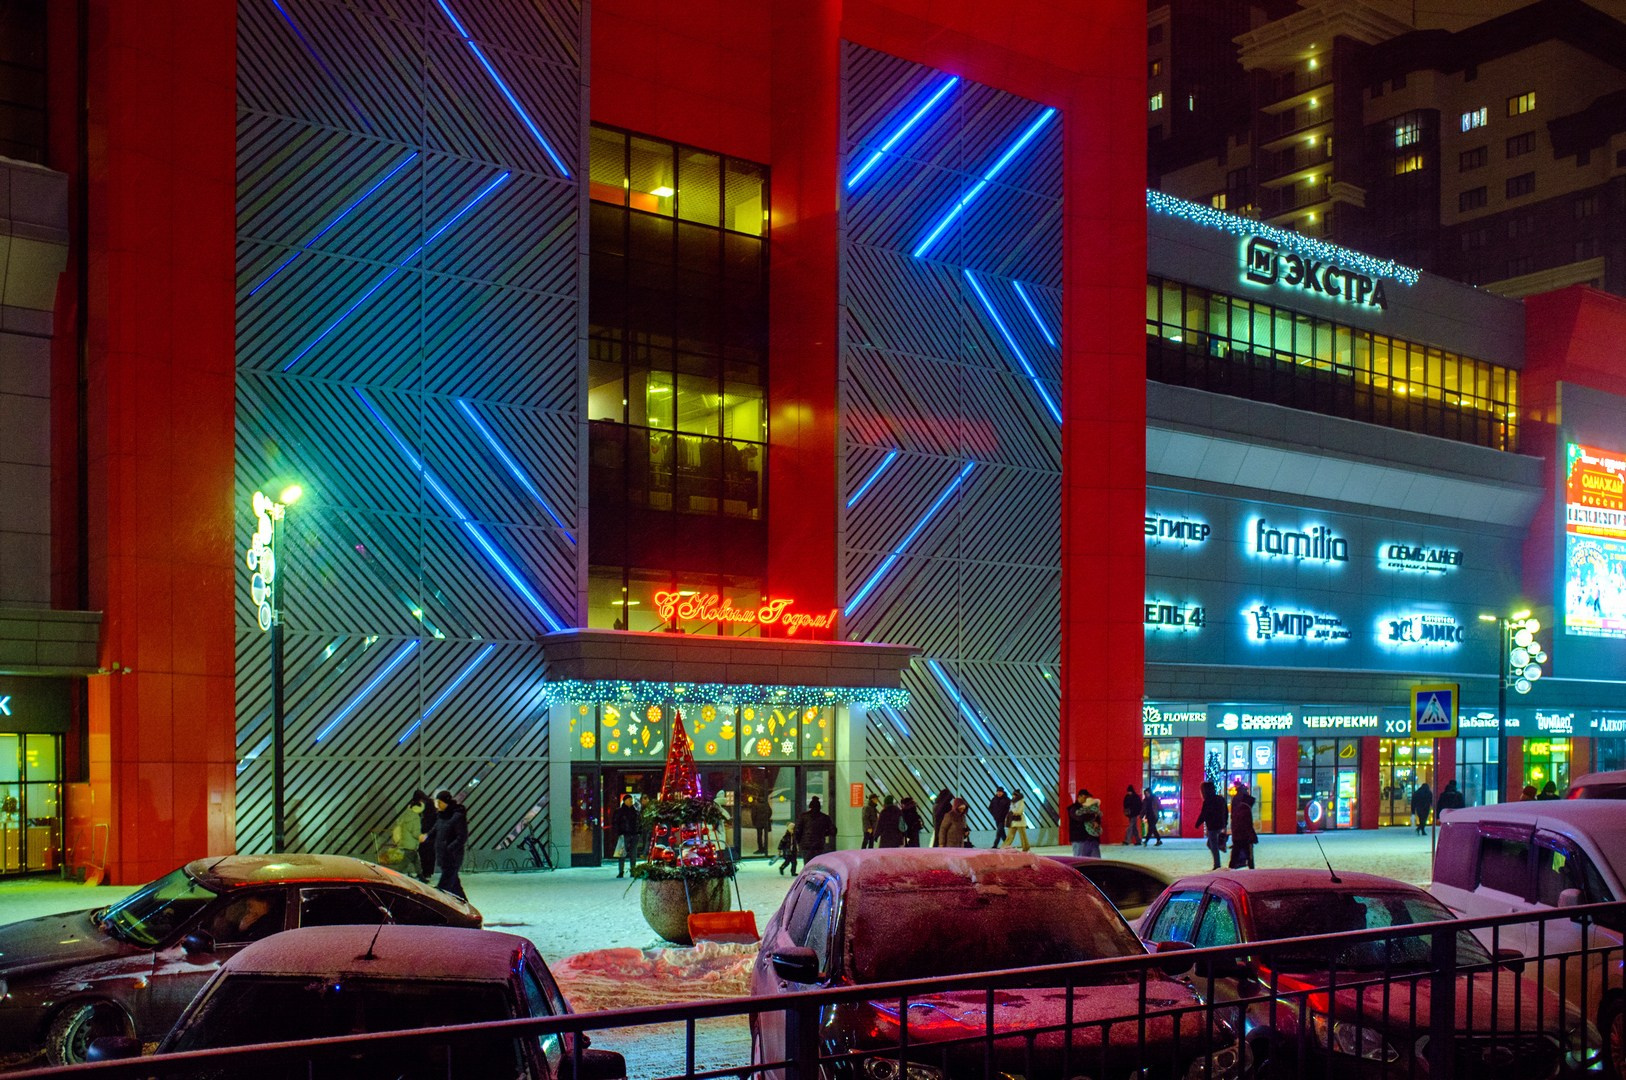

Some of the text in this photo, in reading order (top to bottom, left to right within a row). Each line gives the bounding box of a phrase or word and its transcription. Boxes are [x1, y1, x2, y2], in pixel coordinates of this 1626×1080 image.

[1284, 253, 1388, 310] ЭКСТРА
[1256, 519, 1349, 562] familia
[654, 591, 838, 635] С Новым Годом!
[1188, 607, 1202, 627] 4
[1163, 712, 1207, 722] FLOWERS
[1302, 715, 1378, 728] ЧЕБУРЕКМИ
[1458, 714, 1520, 730] Табакека
[1143, 723, 1173, 736] ЕТЫ
